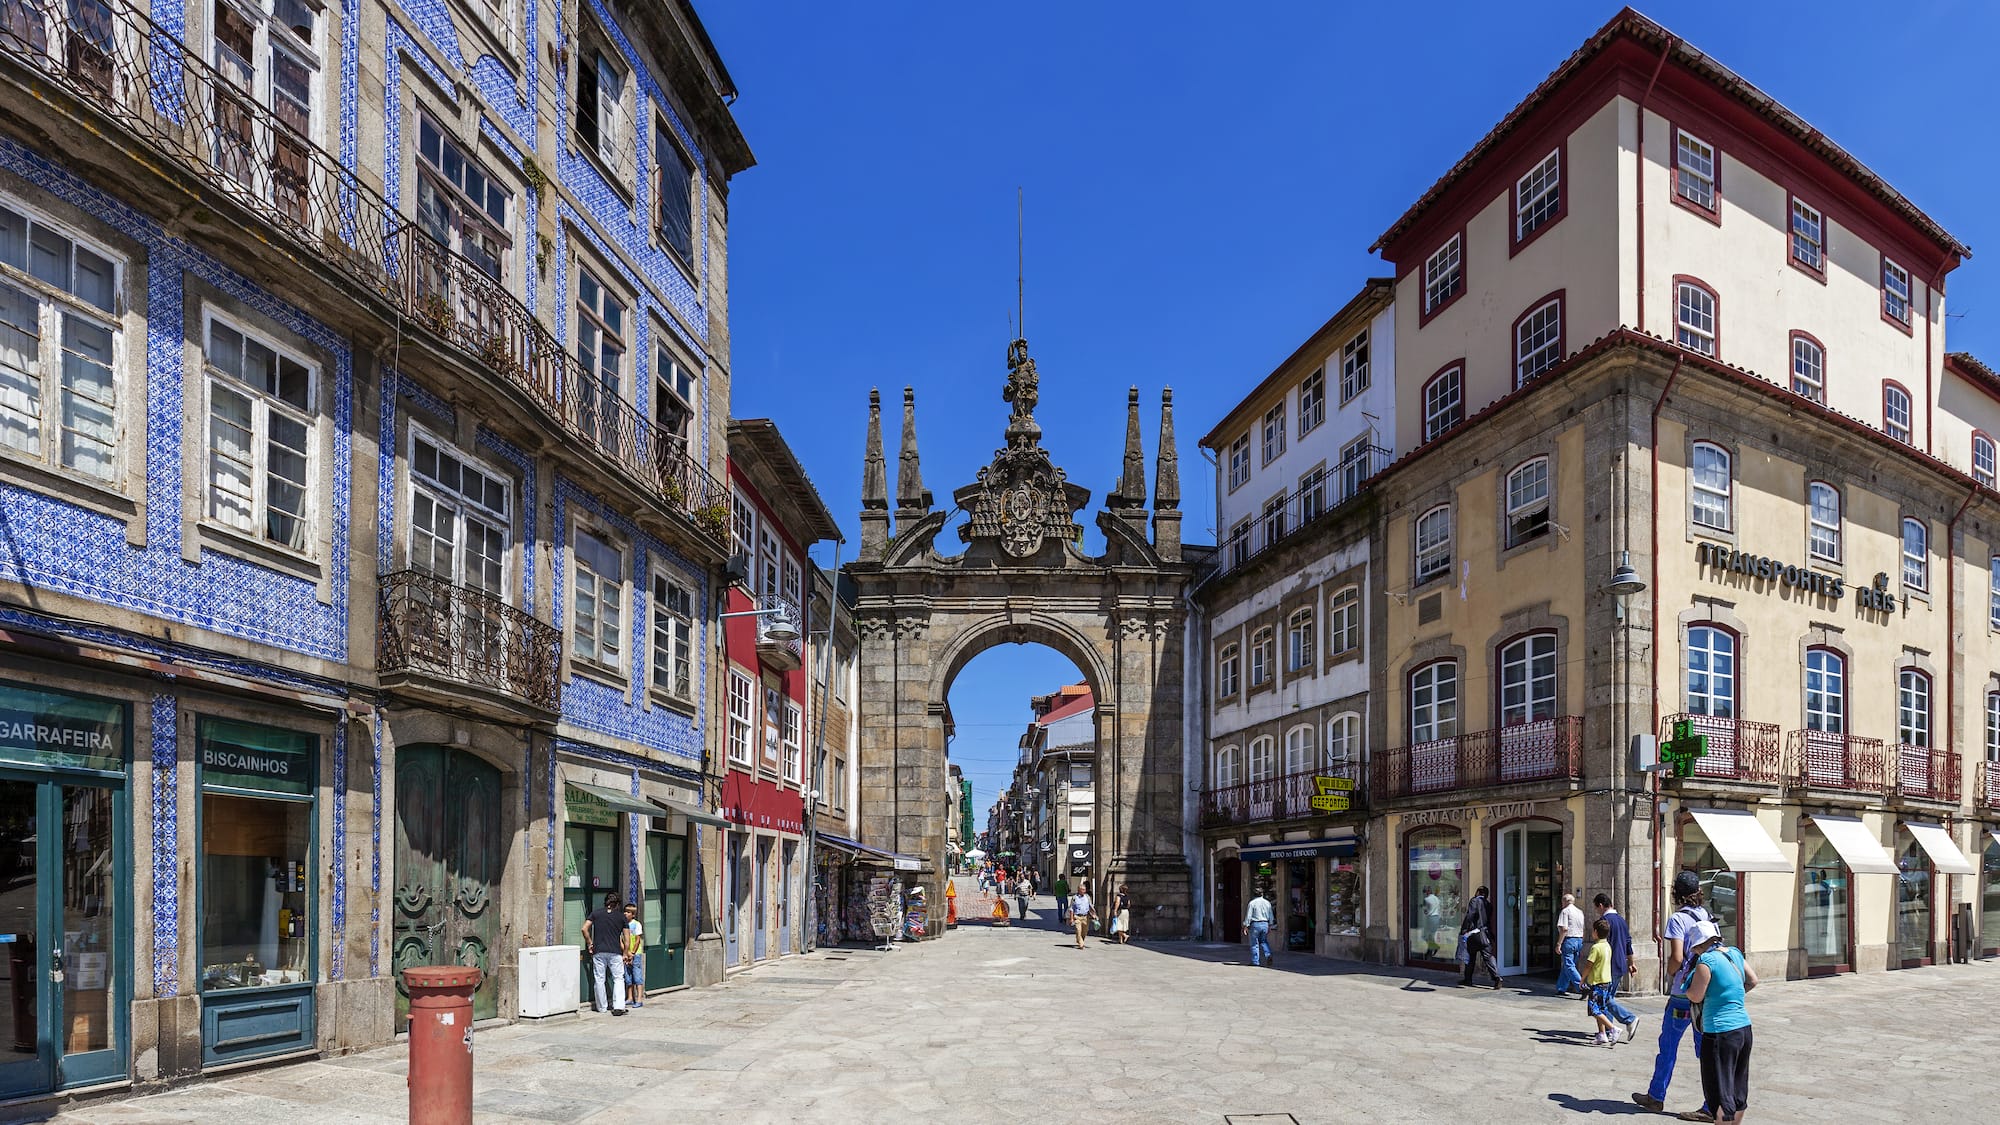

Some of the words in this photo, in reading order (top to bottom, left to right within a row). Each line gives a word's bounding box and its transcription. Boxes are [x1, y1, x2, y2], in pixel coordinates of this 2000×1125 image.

[1699, 541, 1844, 599] TRANSPORTES
[1857, 586, 1896, 614] REIS
[0, 721, 113, 750] GARRAFEIRA
[203, 750, 288, 774] BISCAINHOS
[1313, 797, 1349, 809] DESPORTOS
[1487, 801, 1536, 817] ALVIM
